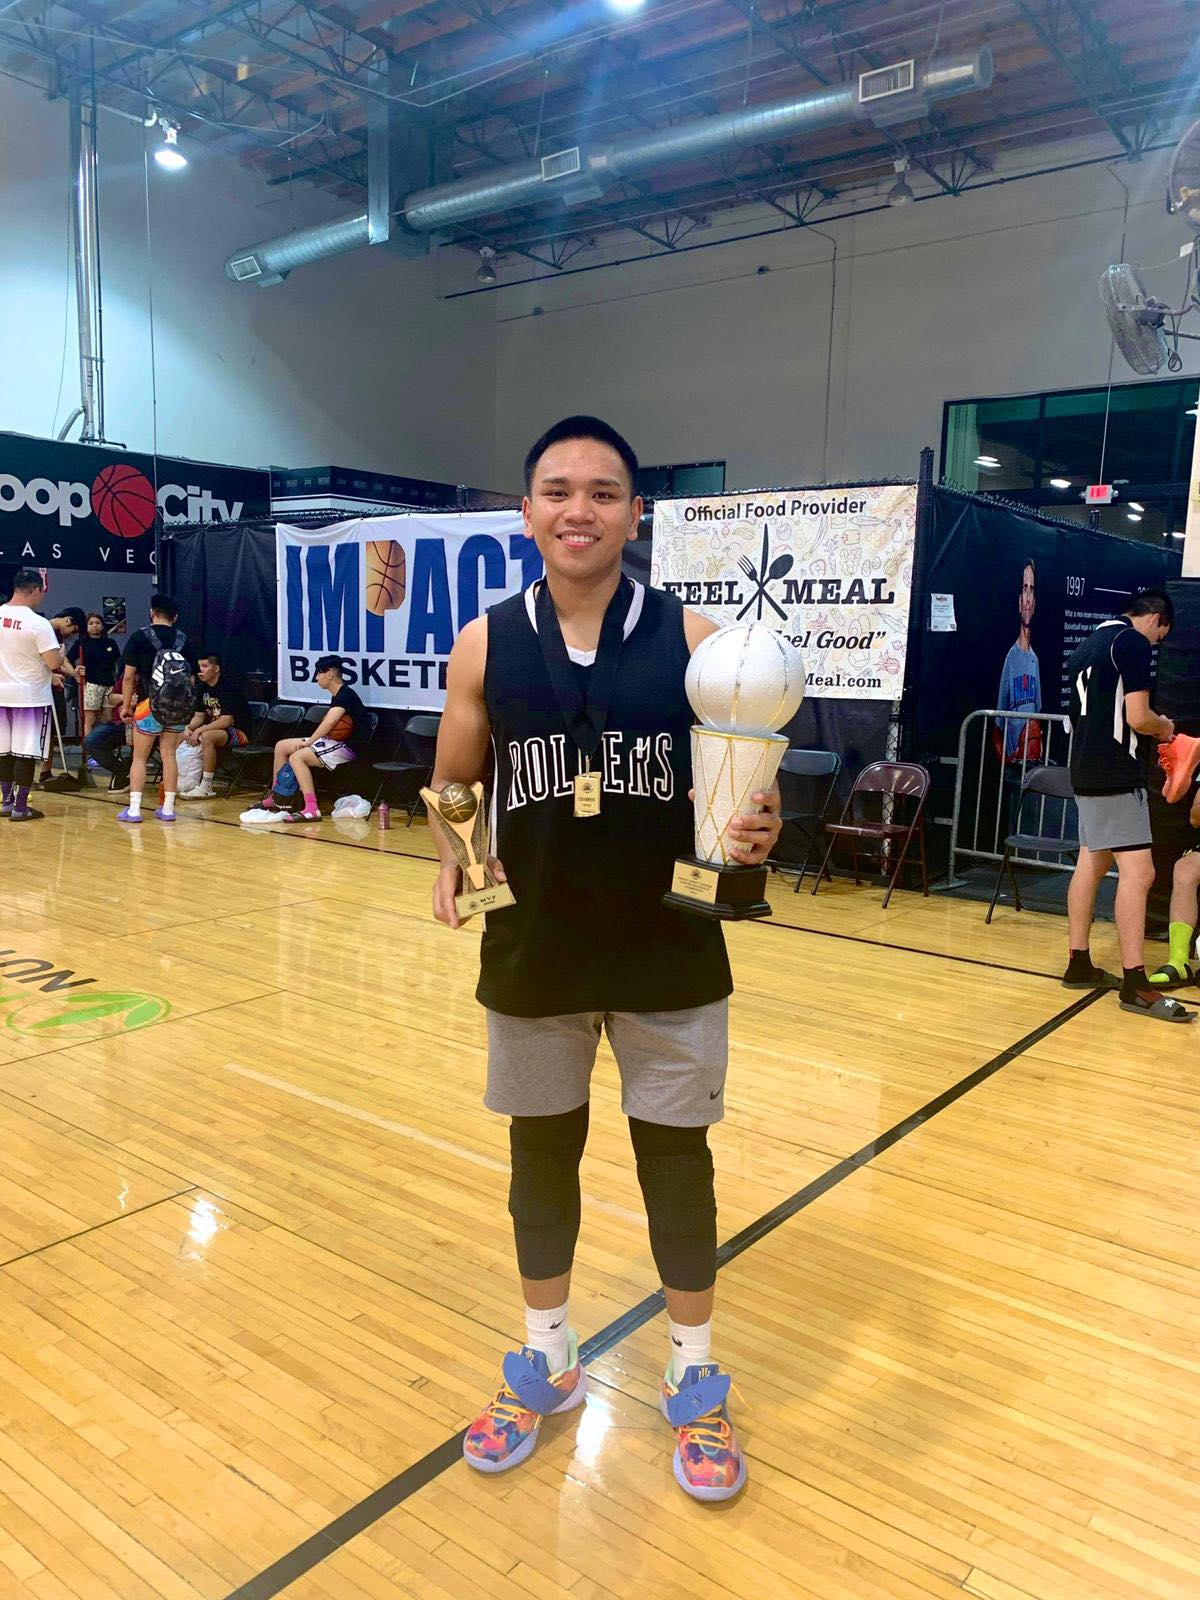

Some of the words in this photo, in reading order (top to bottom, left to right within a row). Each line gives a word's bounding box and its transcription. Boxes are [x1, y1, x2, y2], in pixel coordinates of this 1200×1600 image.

[684, 503, 741, 522] Official
[745, 500, 786, 518] Food
[790, 498, 866, 516] Provider
[0, 541, 61, 559] AS
[663, 581, 744, 605] FEEL
[781, 578, 895, 604] MEAL
[1066, 576, 1085, 596] 1997
[507, 731, 674, 811] ROLERS
